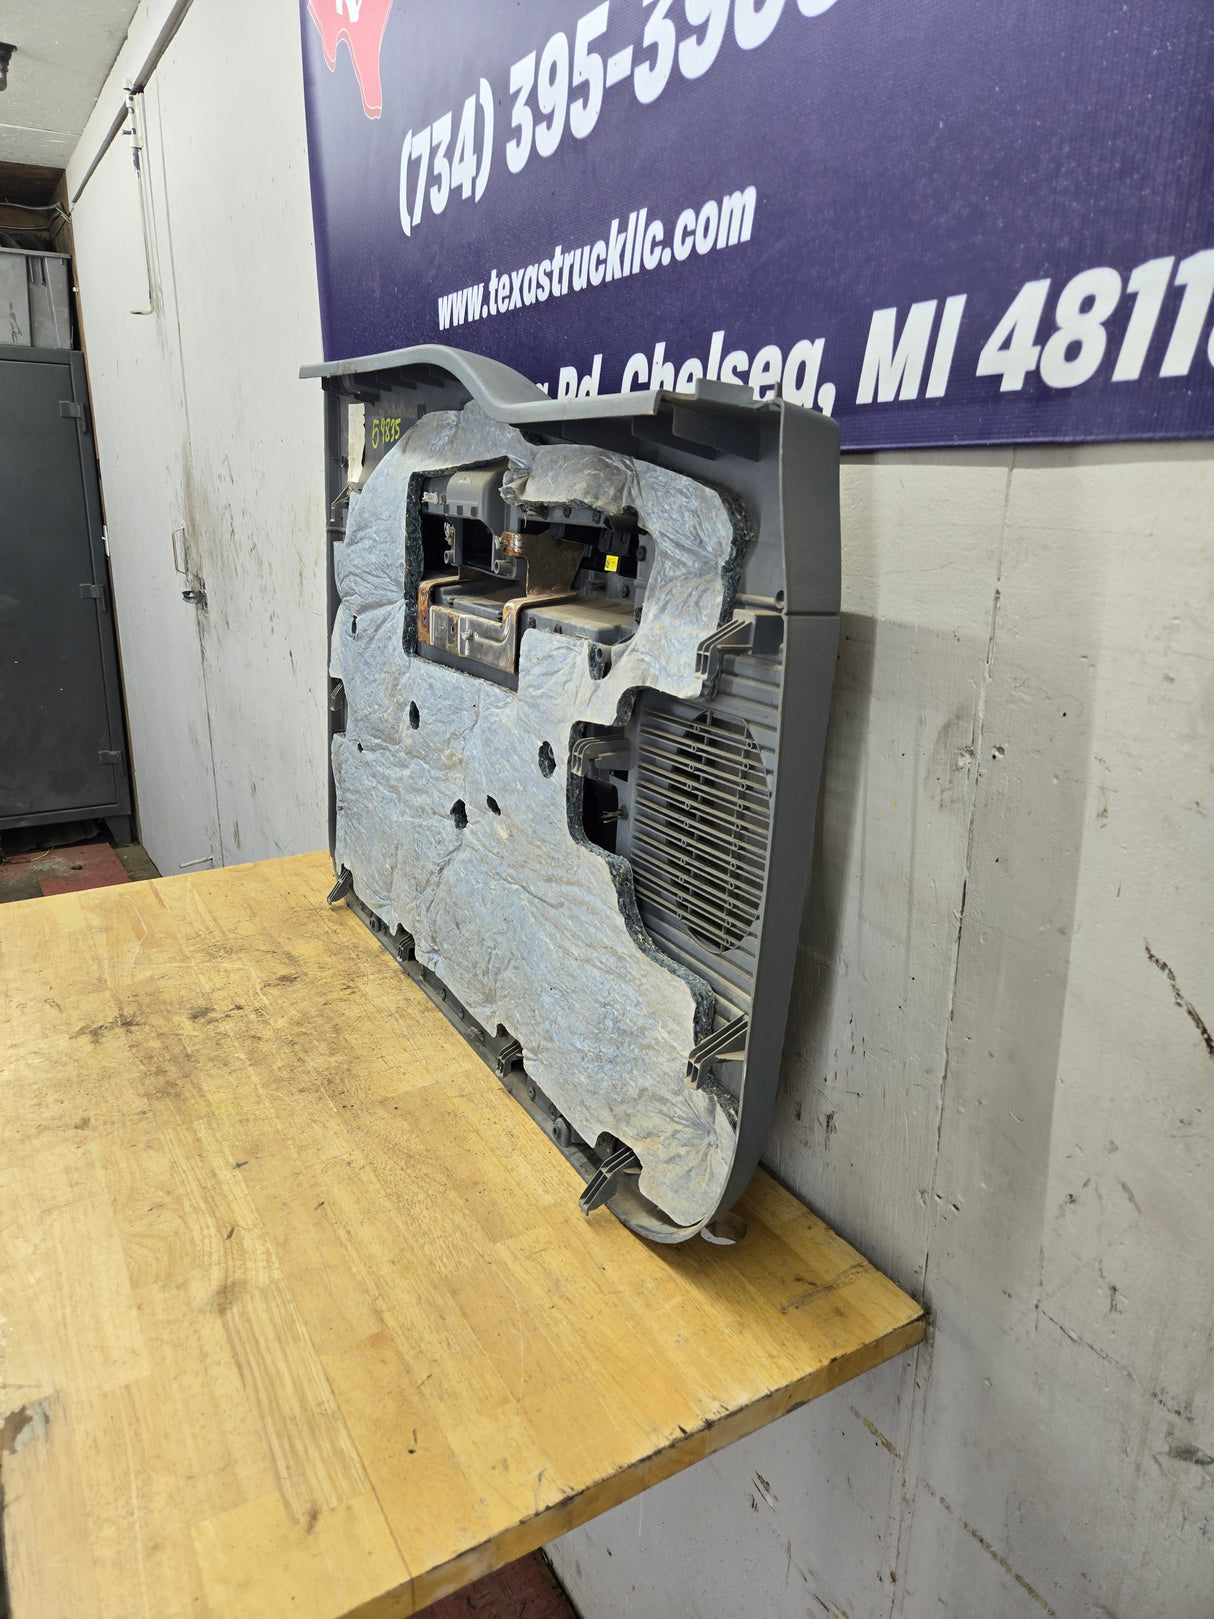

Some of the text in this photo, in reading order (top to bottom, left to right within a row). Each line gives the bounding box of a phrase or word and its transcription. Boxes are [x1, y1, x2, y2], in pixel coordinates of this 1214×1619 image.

[400, 0, 838, 237] (734) 395-39
[438, 186, 757, 330] www.texastruckllc.com
[856, 294, 967, 404] MI
[975, 248, 1214, 391] 4811
